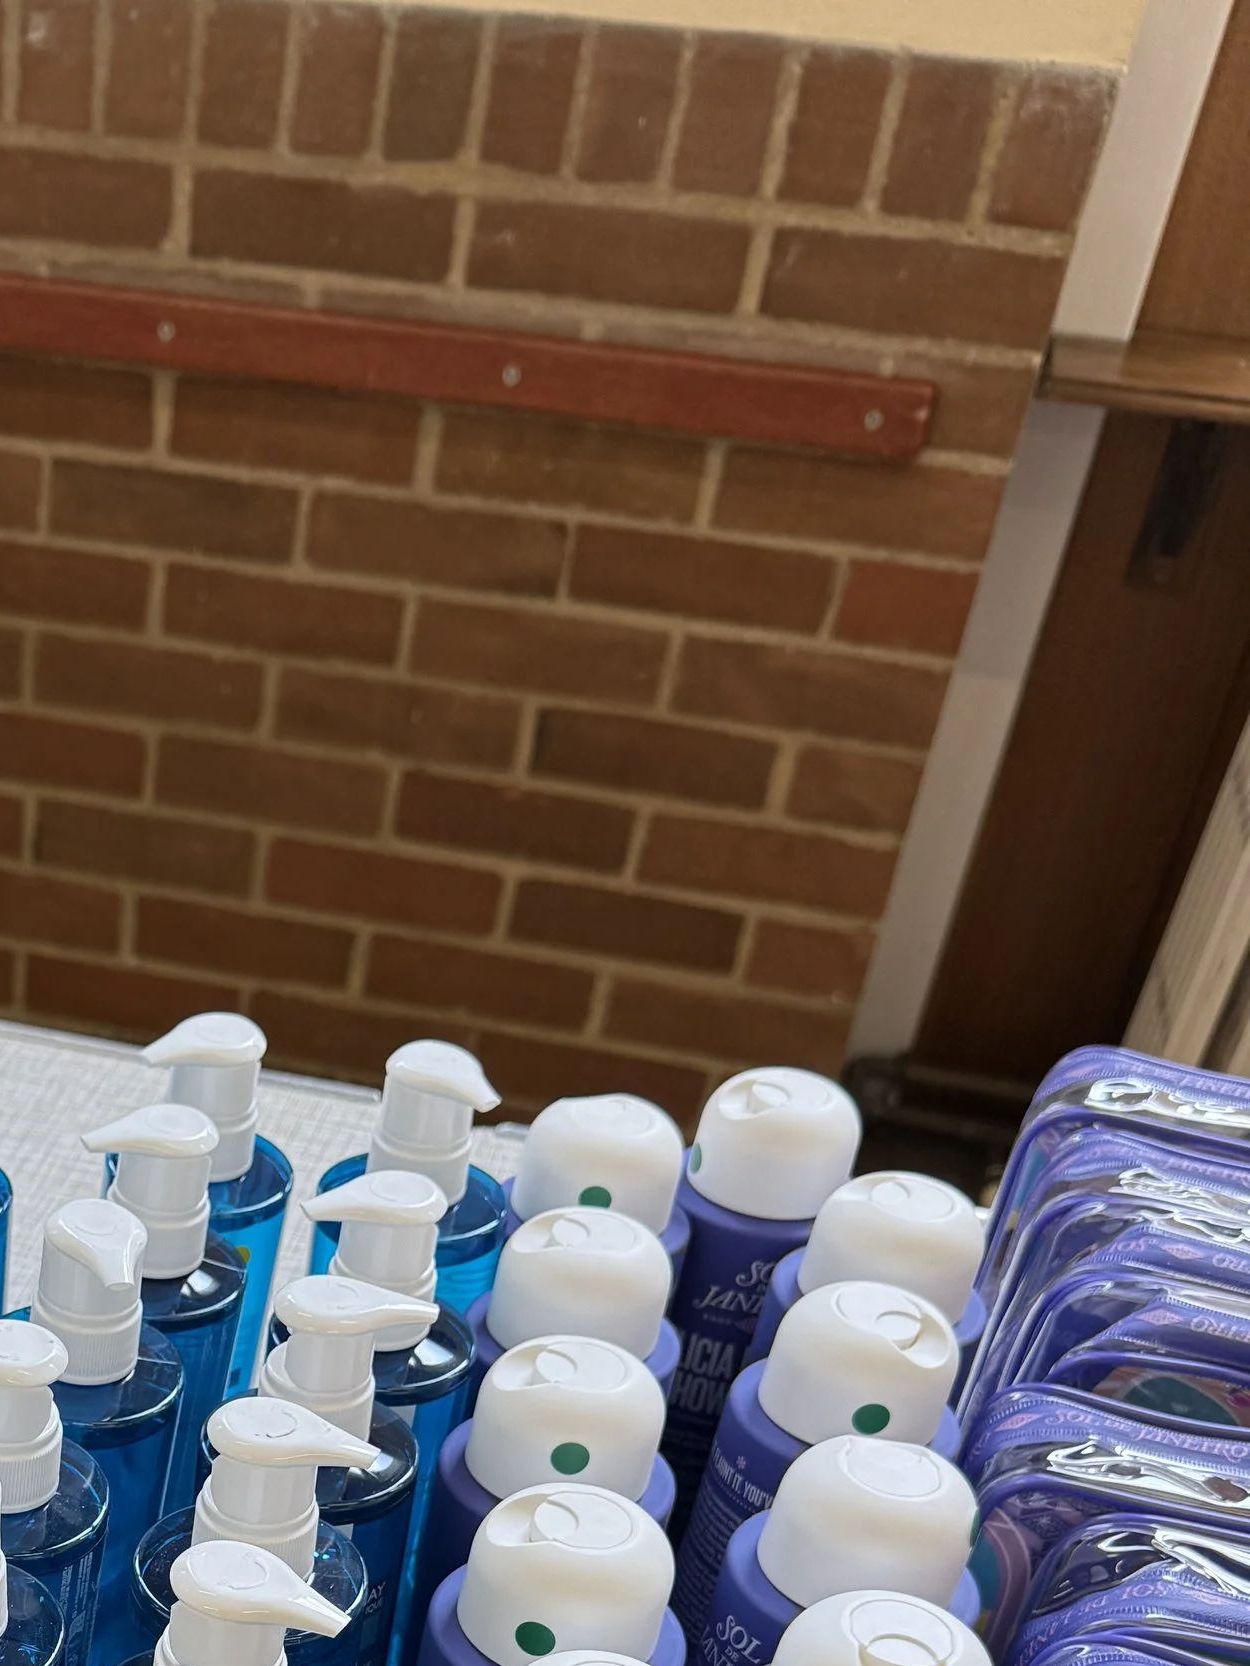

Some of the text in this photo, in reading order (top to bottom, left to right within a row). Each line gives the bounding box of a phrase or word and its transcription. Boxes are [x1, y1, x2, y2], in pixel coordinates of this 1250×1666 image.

[1133, 1426, 1250, 1463] JANEIRO
[744, 1483, 773, 1509] YOU'V
[716, 1615, 762, 1664] SOL
[725, 1645, 740, 1662] DE
